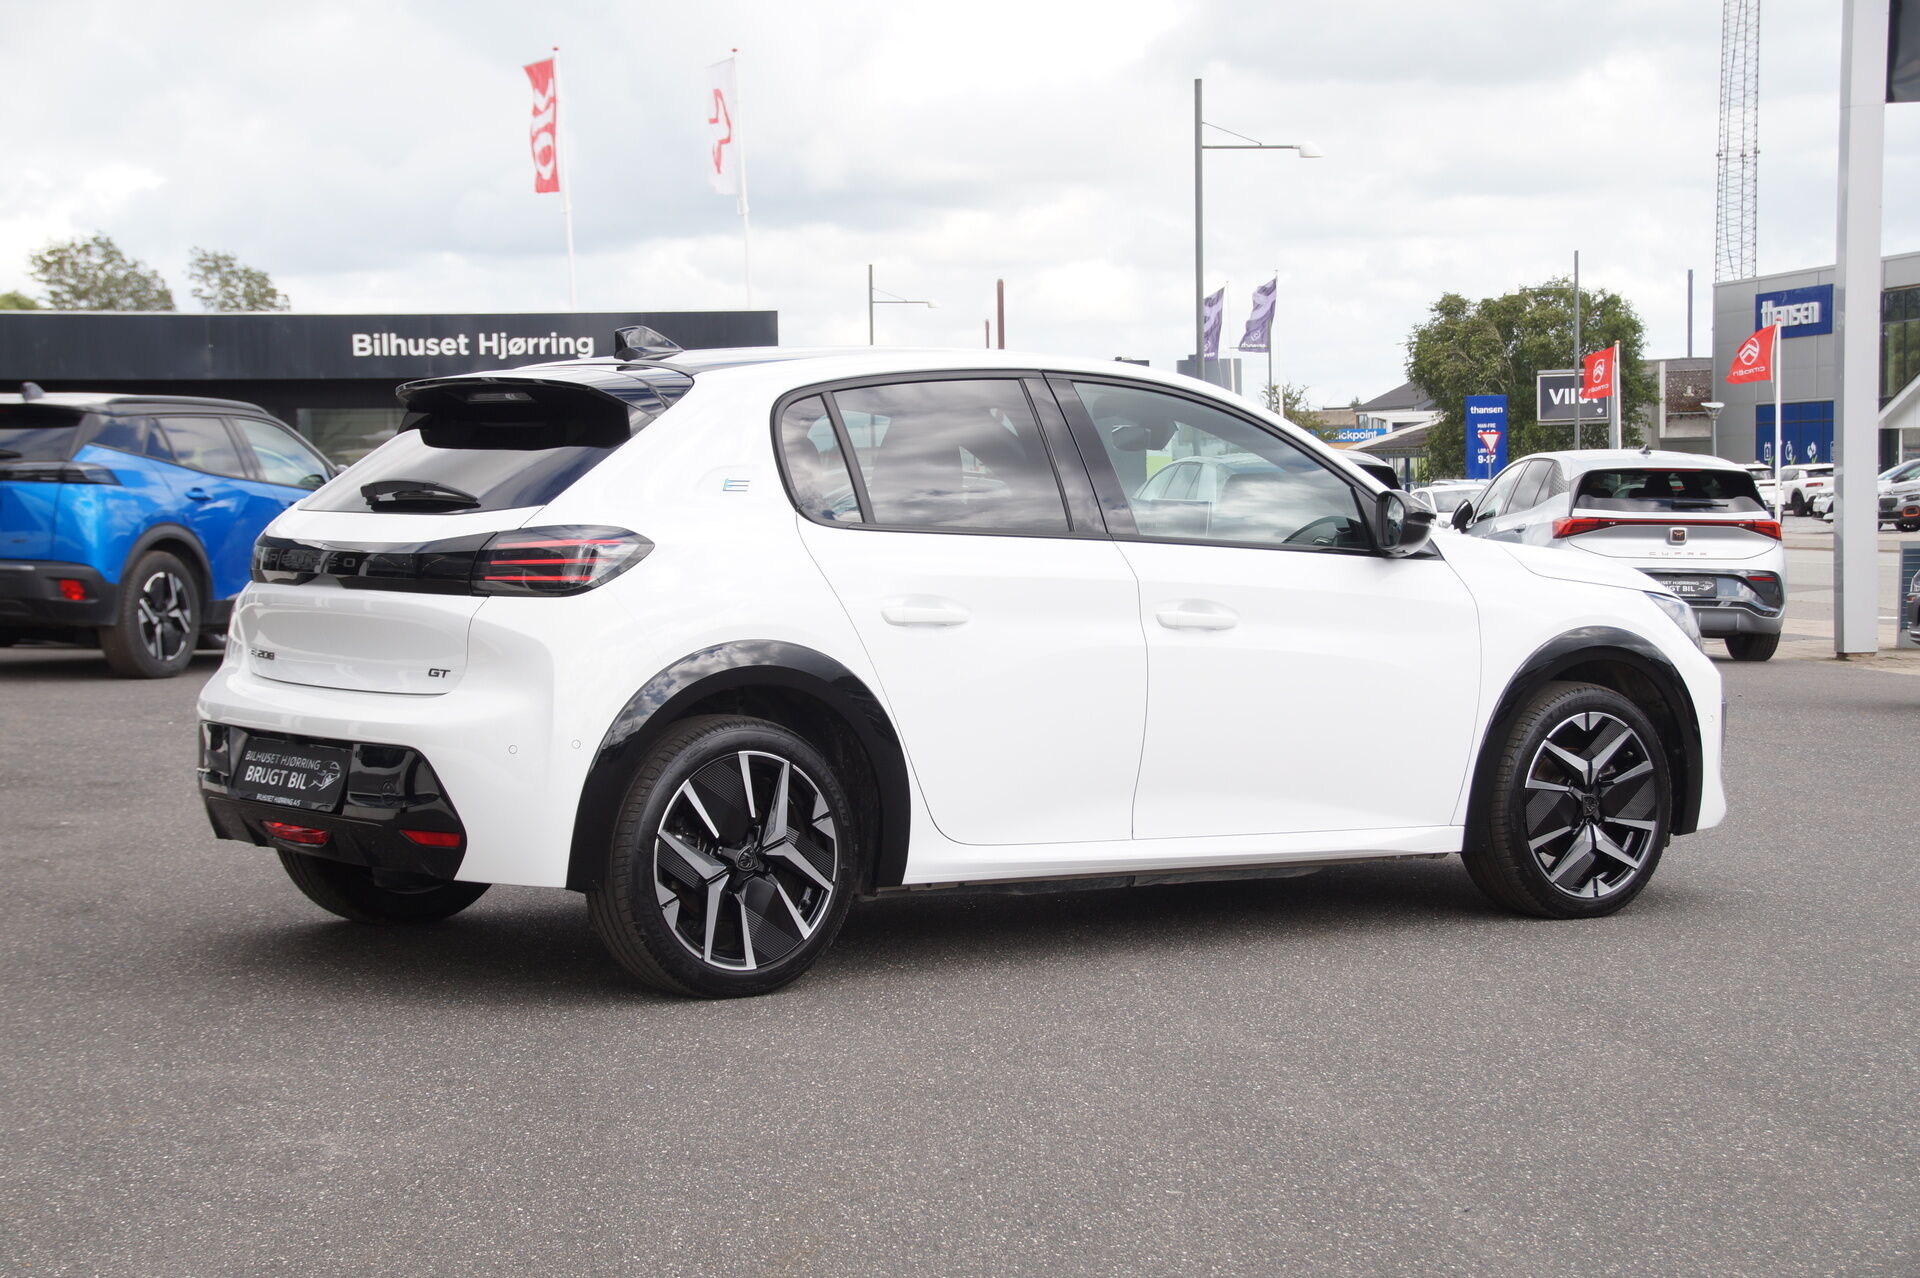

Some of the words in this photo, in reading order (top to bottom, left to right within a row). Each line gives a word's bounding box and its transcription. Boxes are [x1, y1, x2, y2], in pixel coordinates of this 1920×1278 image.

[1761, 300, 1820, 328] thansen
[352, 333, 469, 356] Bilhuset
[479, 332, 593, 359] Hjørring
[1471, 406, 1503, 414] thansen
[428, 668, 451, 679] GT
[245, 750, 281, 764] BILHUSET
[280, 755, 322, 770] HJØRRING
[245, 765, 289, 786] BRUGT
[287, 772, 307, 790] BIL
